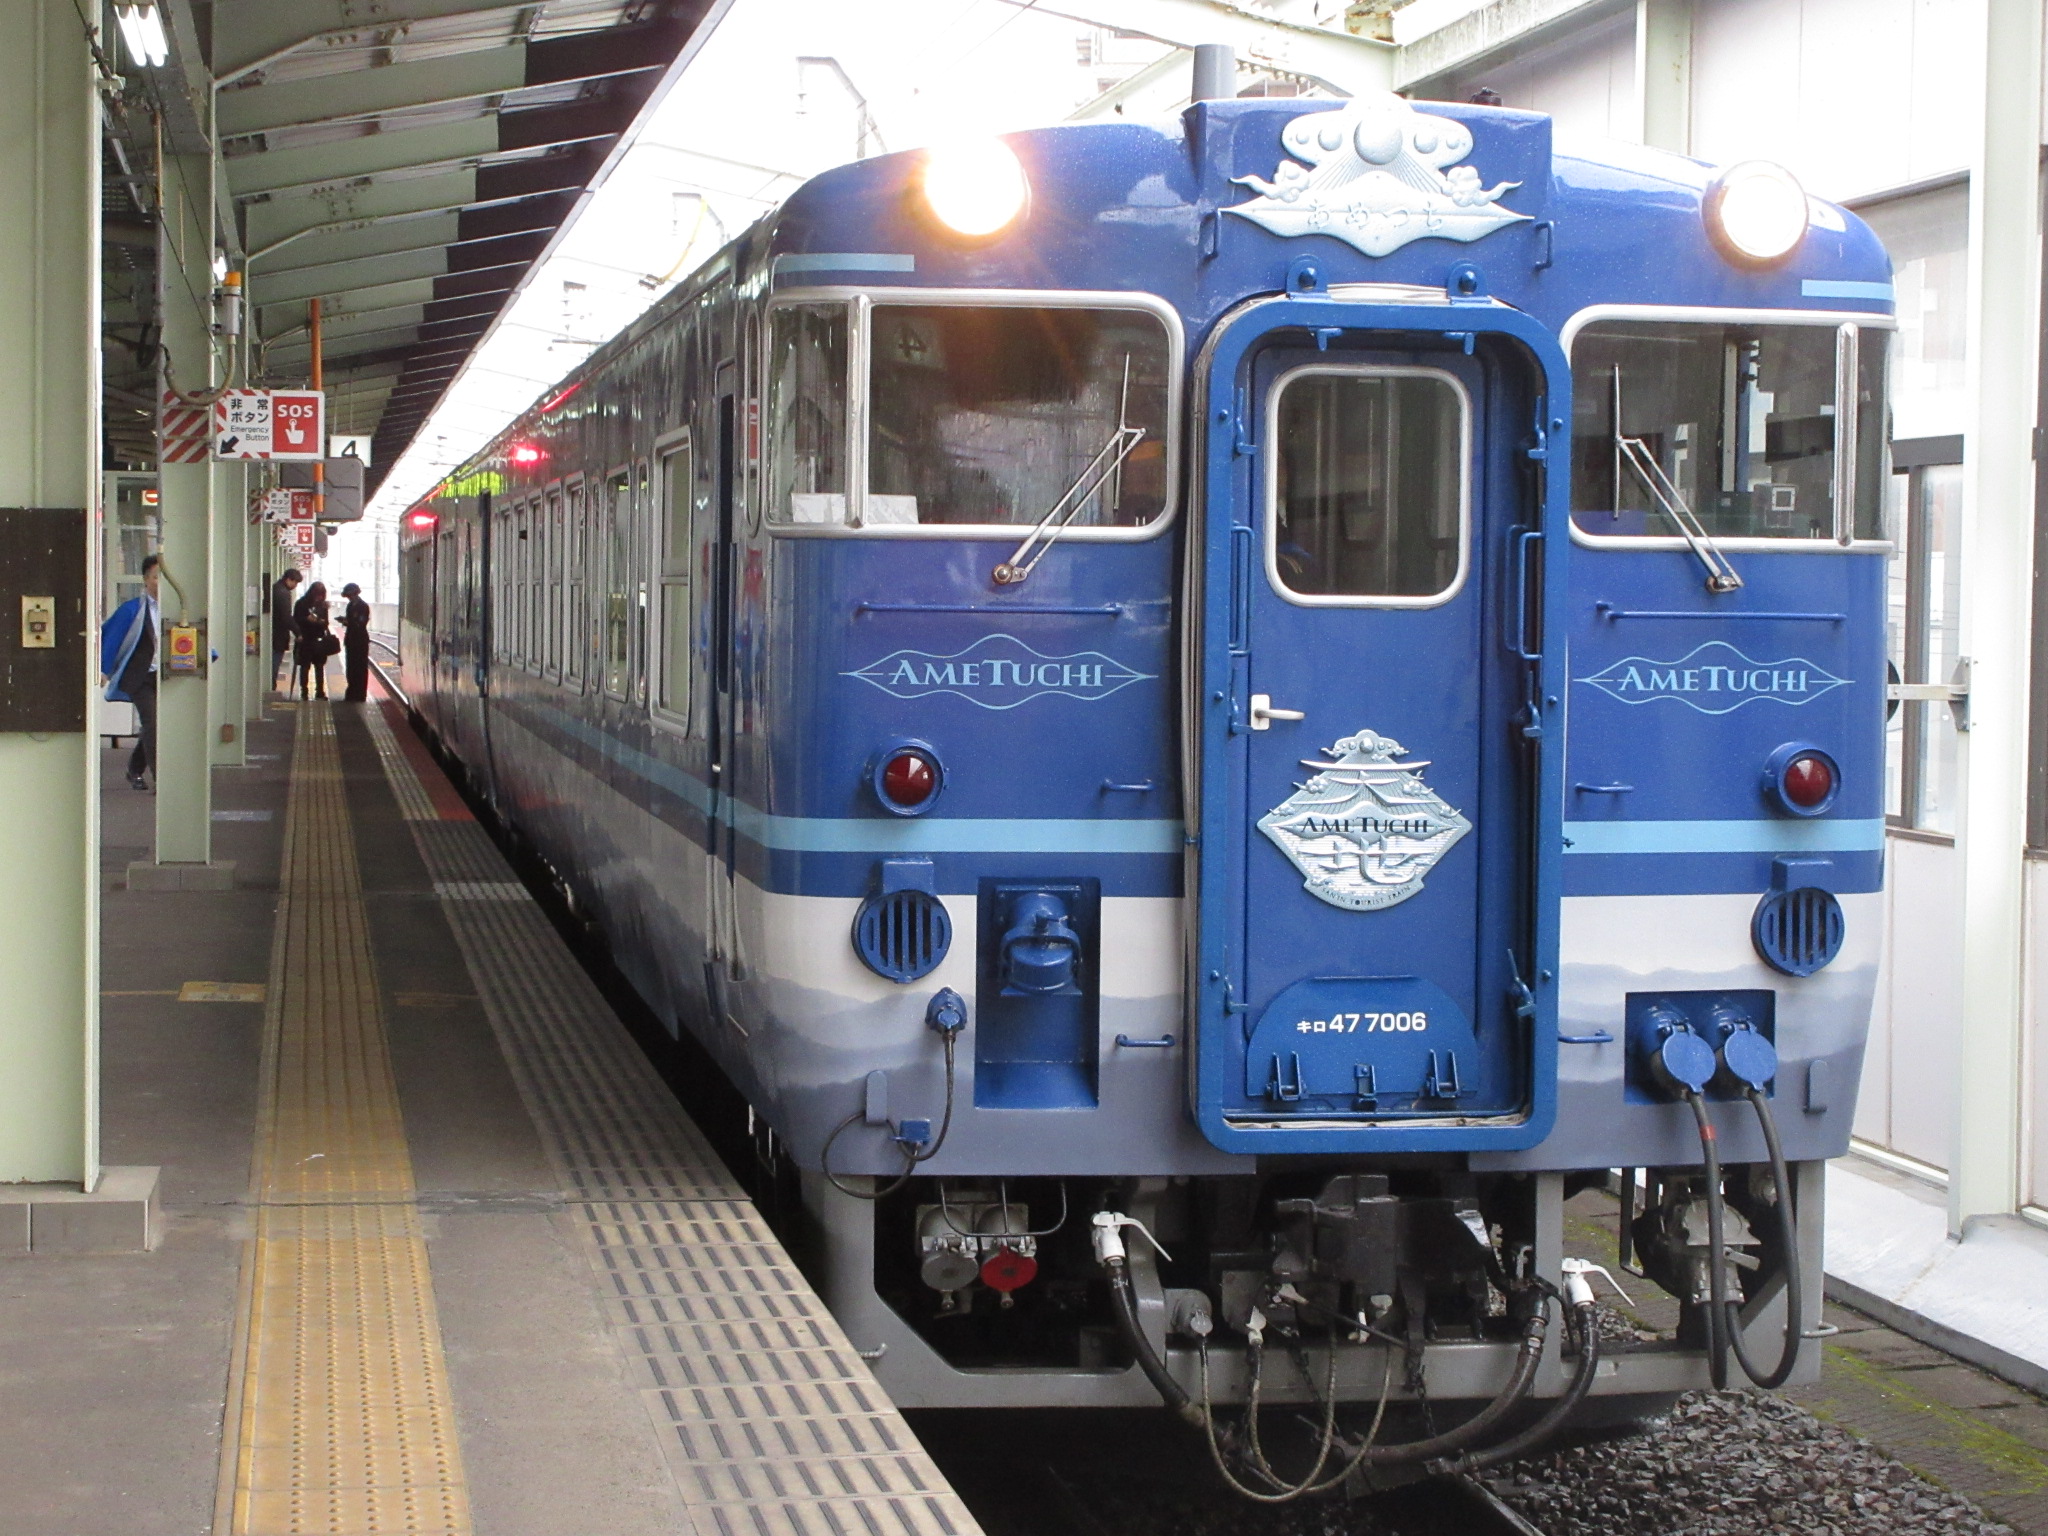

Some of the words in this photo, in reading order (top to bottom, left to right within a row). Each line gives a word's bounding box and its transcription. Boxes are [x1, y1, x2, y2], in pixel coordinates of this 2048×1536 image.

[1307, 198, 1443, 231] あめつち
[231, 398, 269, 410] 非常
[231, 411, 269, 423] ボタン
[277, 404, 313, 418] SOS
[230, 425, 269, 433] Emergency
[245, 433, 270, 441] Button
